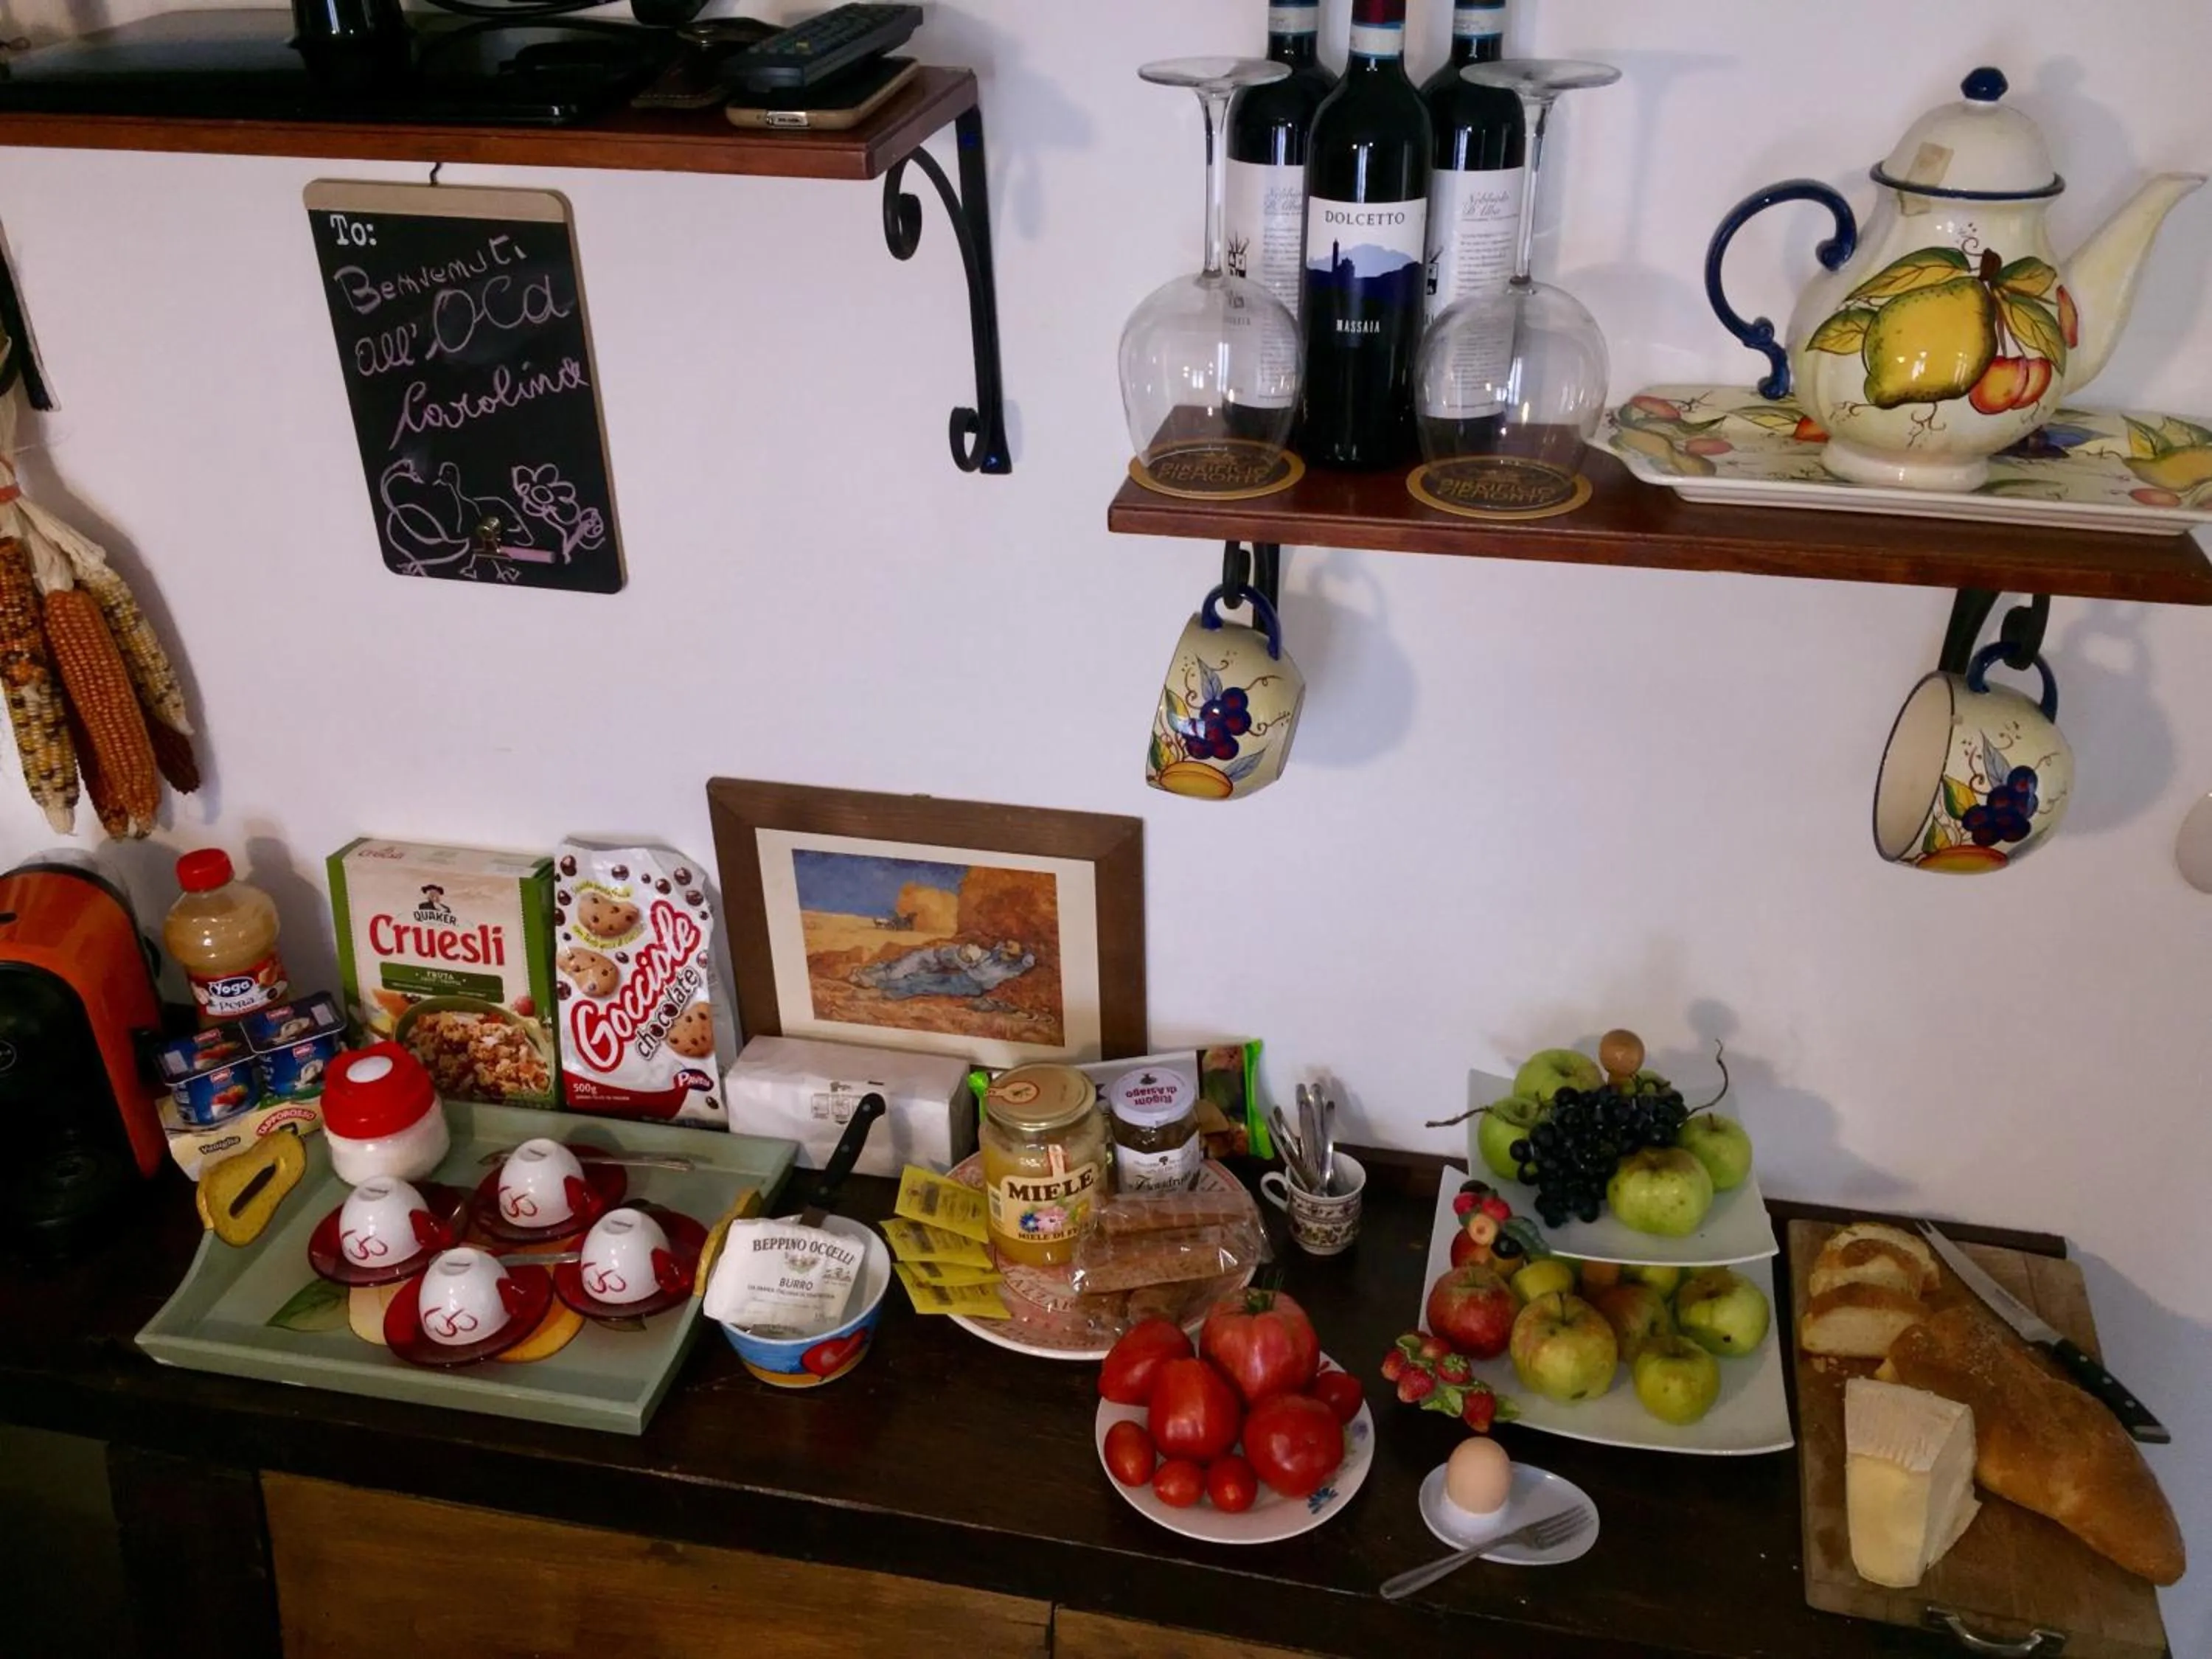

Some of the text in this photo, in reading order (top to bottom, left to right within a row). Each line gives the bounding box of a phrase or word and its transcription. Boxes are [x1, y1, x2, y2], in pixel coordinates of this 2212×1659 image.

[1324, 210, 1405, 225] DOLCETTO
[330, 215, 377, 246] To:
[1335, 319, 1381, 333] MASSAIA
[414, 911, 457, 925] QUAKER
[369, 914, 506, 966] Cruesli
[214, 980, 251, 995] Yoga
[573, 902, 700, 1071] Gocciole
[636, 967, 698, 1059] chocolate
[572, 1082, 598, 1095] 500g
[1006, 1169, 1094, 1202] MIELE
[1018, 1231, 1051, 1240] MIELE
[752, 1237, 856, 1265] BEPPINO OCCELLI
[779, 1277, 814, 1291] BURRO
